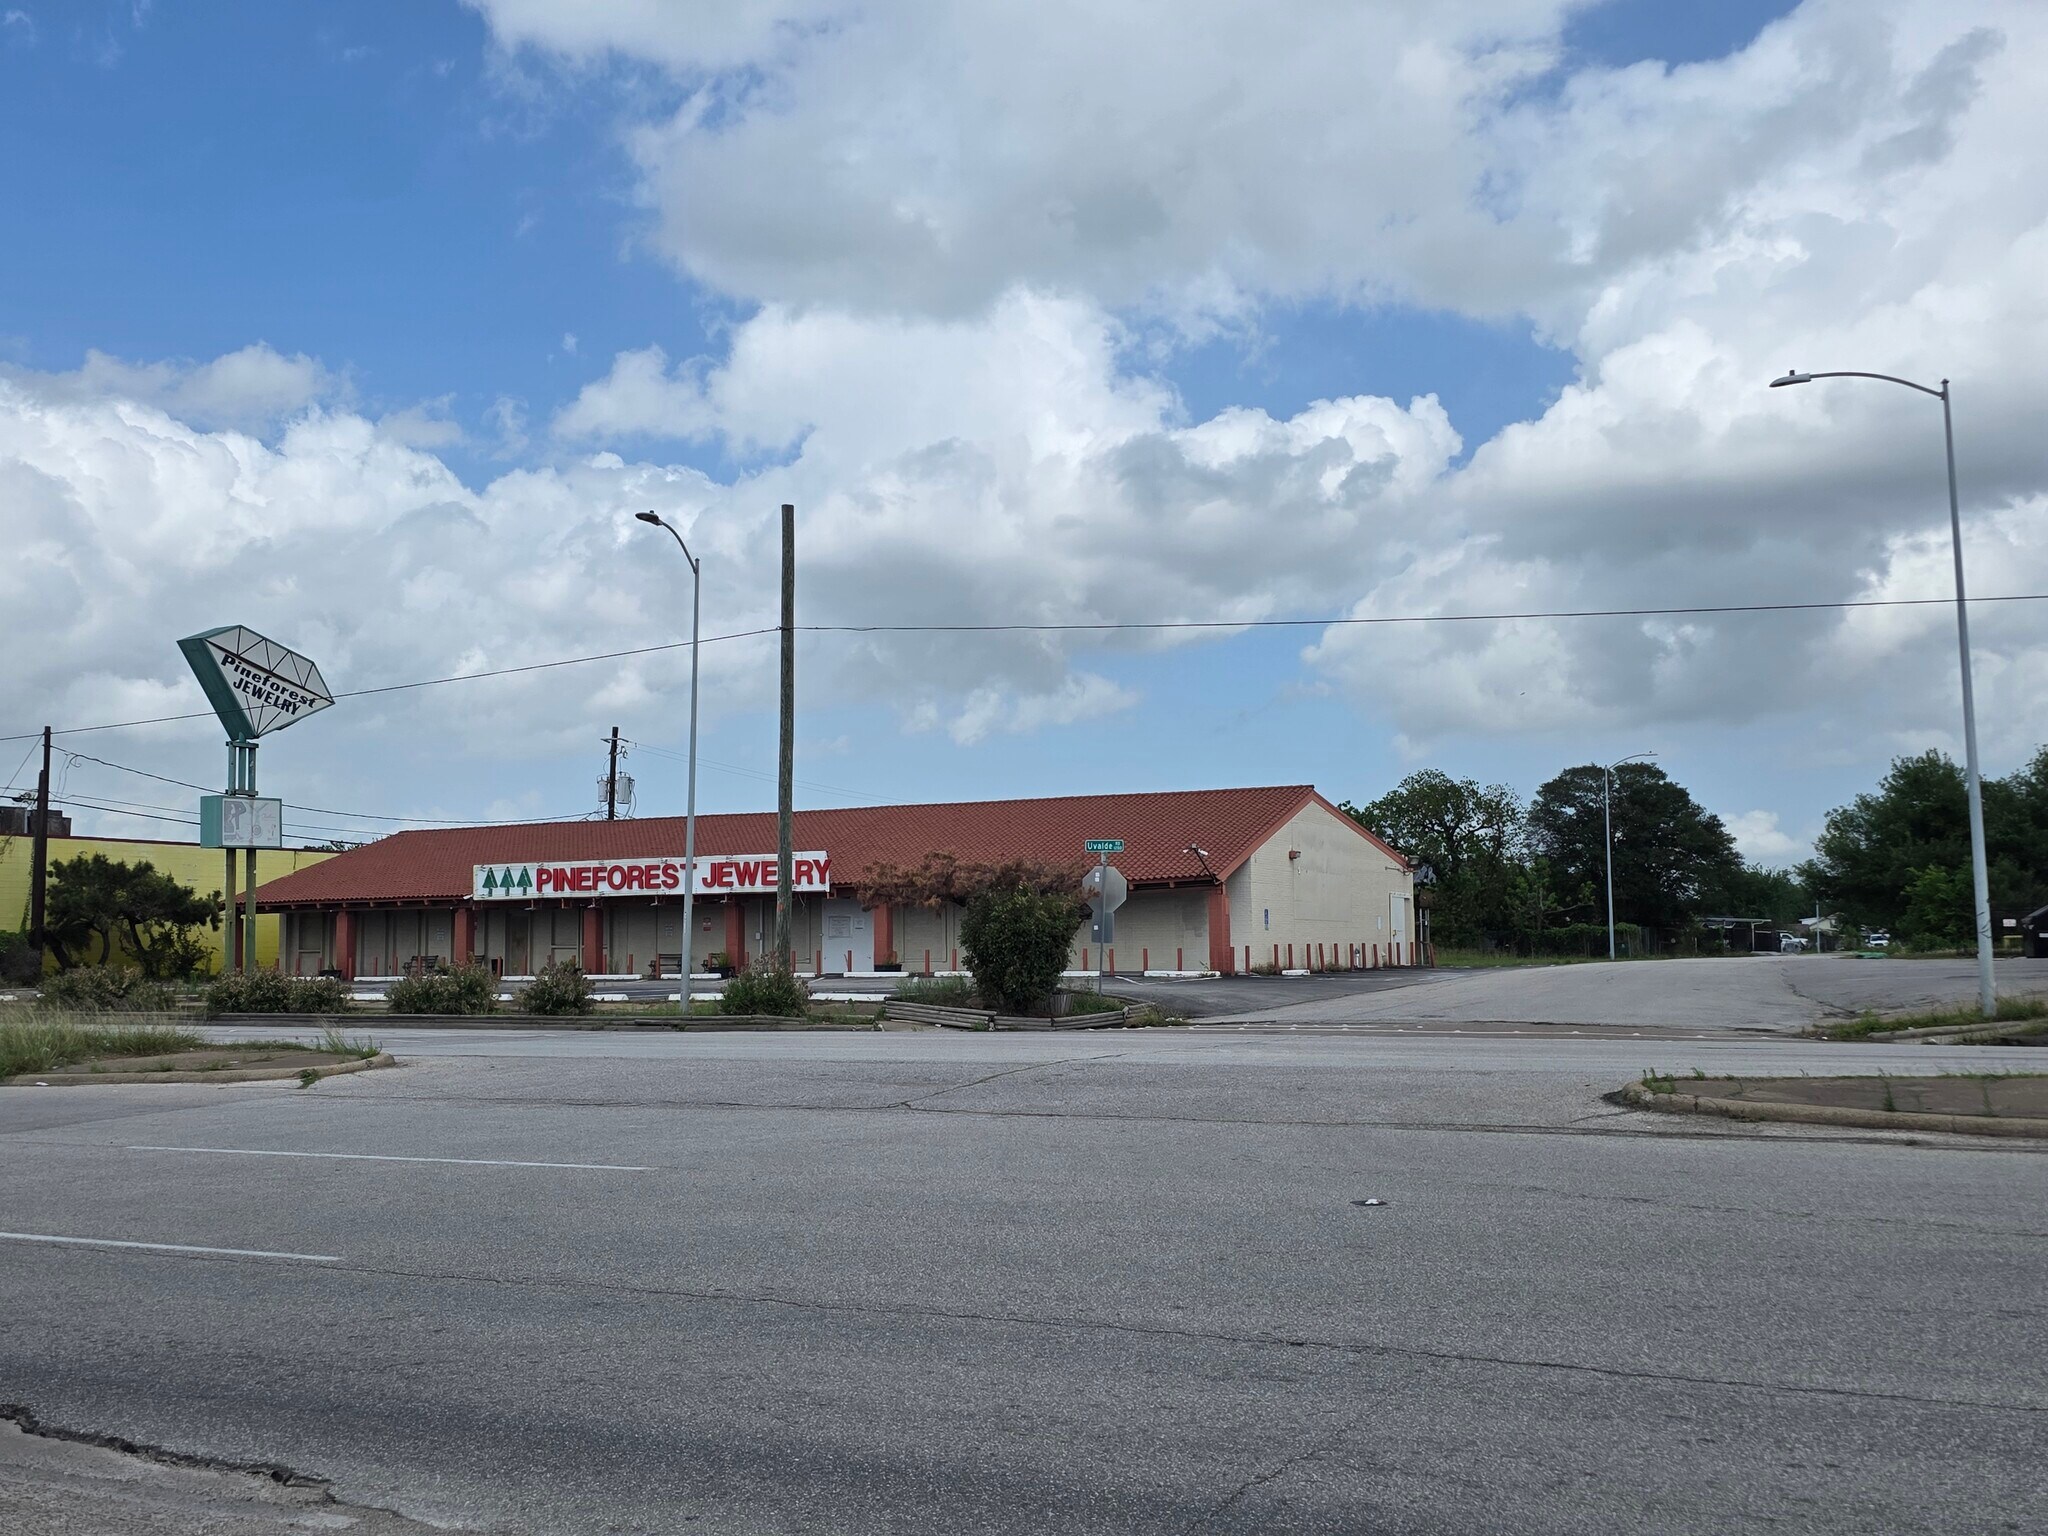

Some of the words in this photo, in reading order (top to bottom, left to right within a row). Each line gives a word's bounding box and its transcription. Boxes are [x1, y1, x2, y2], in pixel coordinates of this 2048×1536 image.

[220, 653, 317, 708] Pineforest
[232, 677, 301, 716] JEWELRY
[1087, 842, 1113, 850] Uvalde
[702, 859, 832, 890] JEWERY
